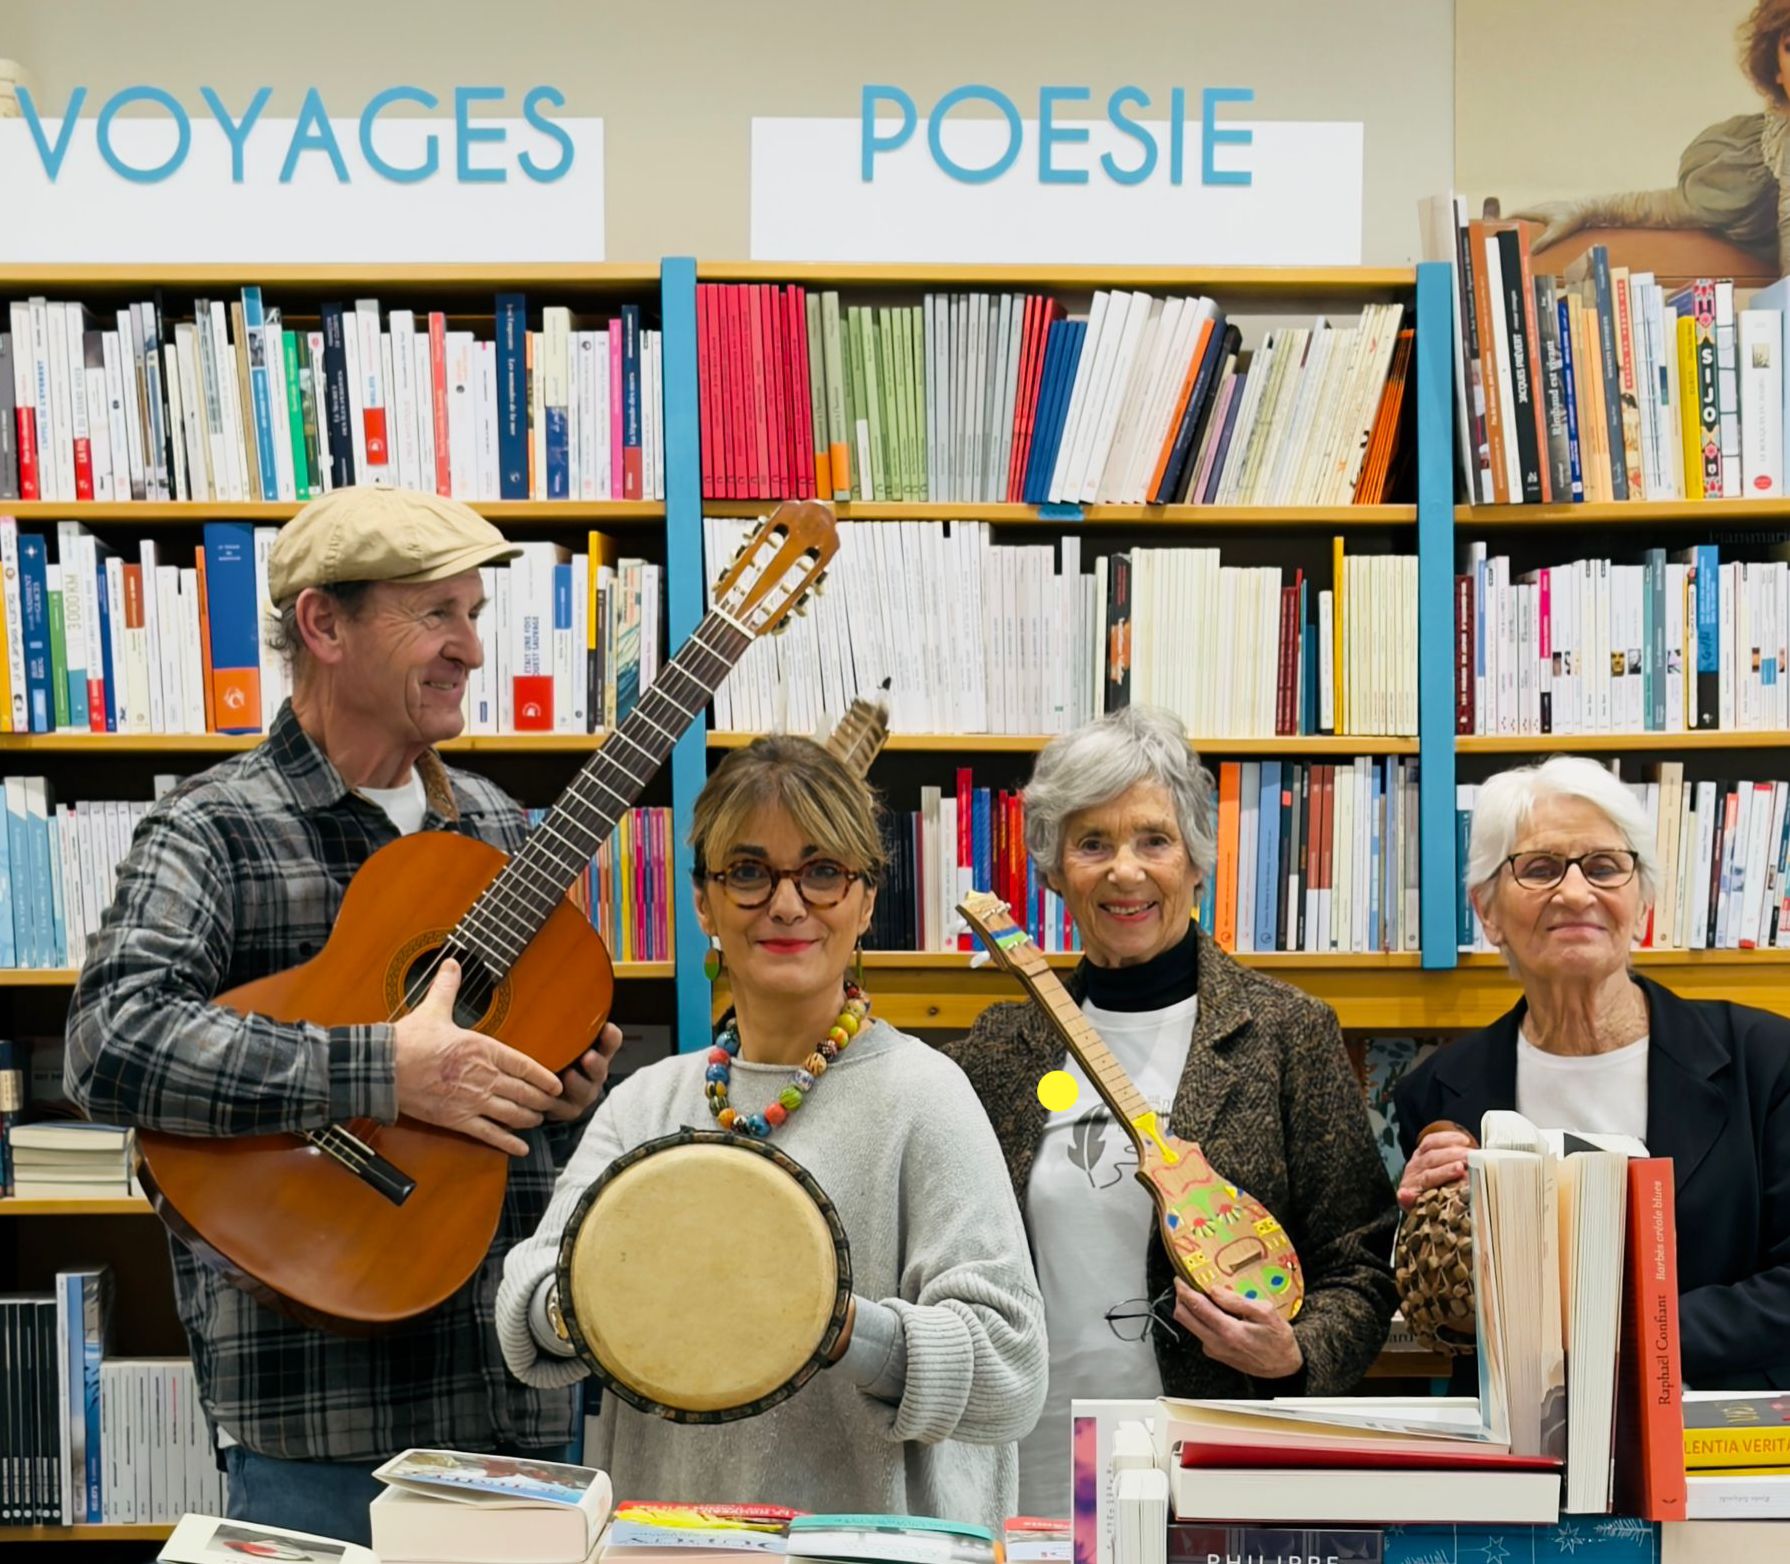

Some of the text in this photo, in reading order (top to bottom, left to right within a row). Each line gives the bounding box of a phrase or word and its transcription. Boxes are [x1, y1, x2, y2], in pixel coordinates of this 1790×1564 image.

[14, 86, 576, 183] VOYAGES
[861, 84, 1255, 185] POESIE
[1650, 1181, 1666, 1281] Barbès créole blues
[1654, 1294, 1674, 1405] Raphaël Confiant
